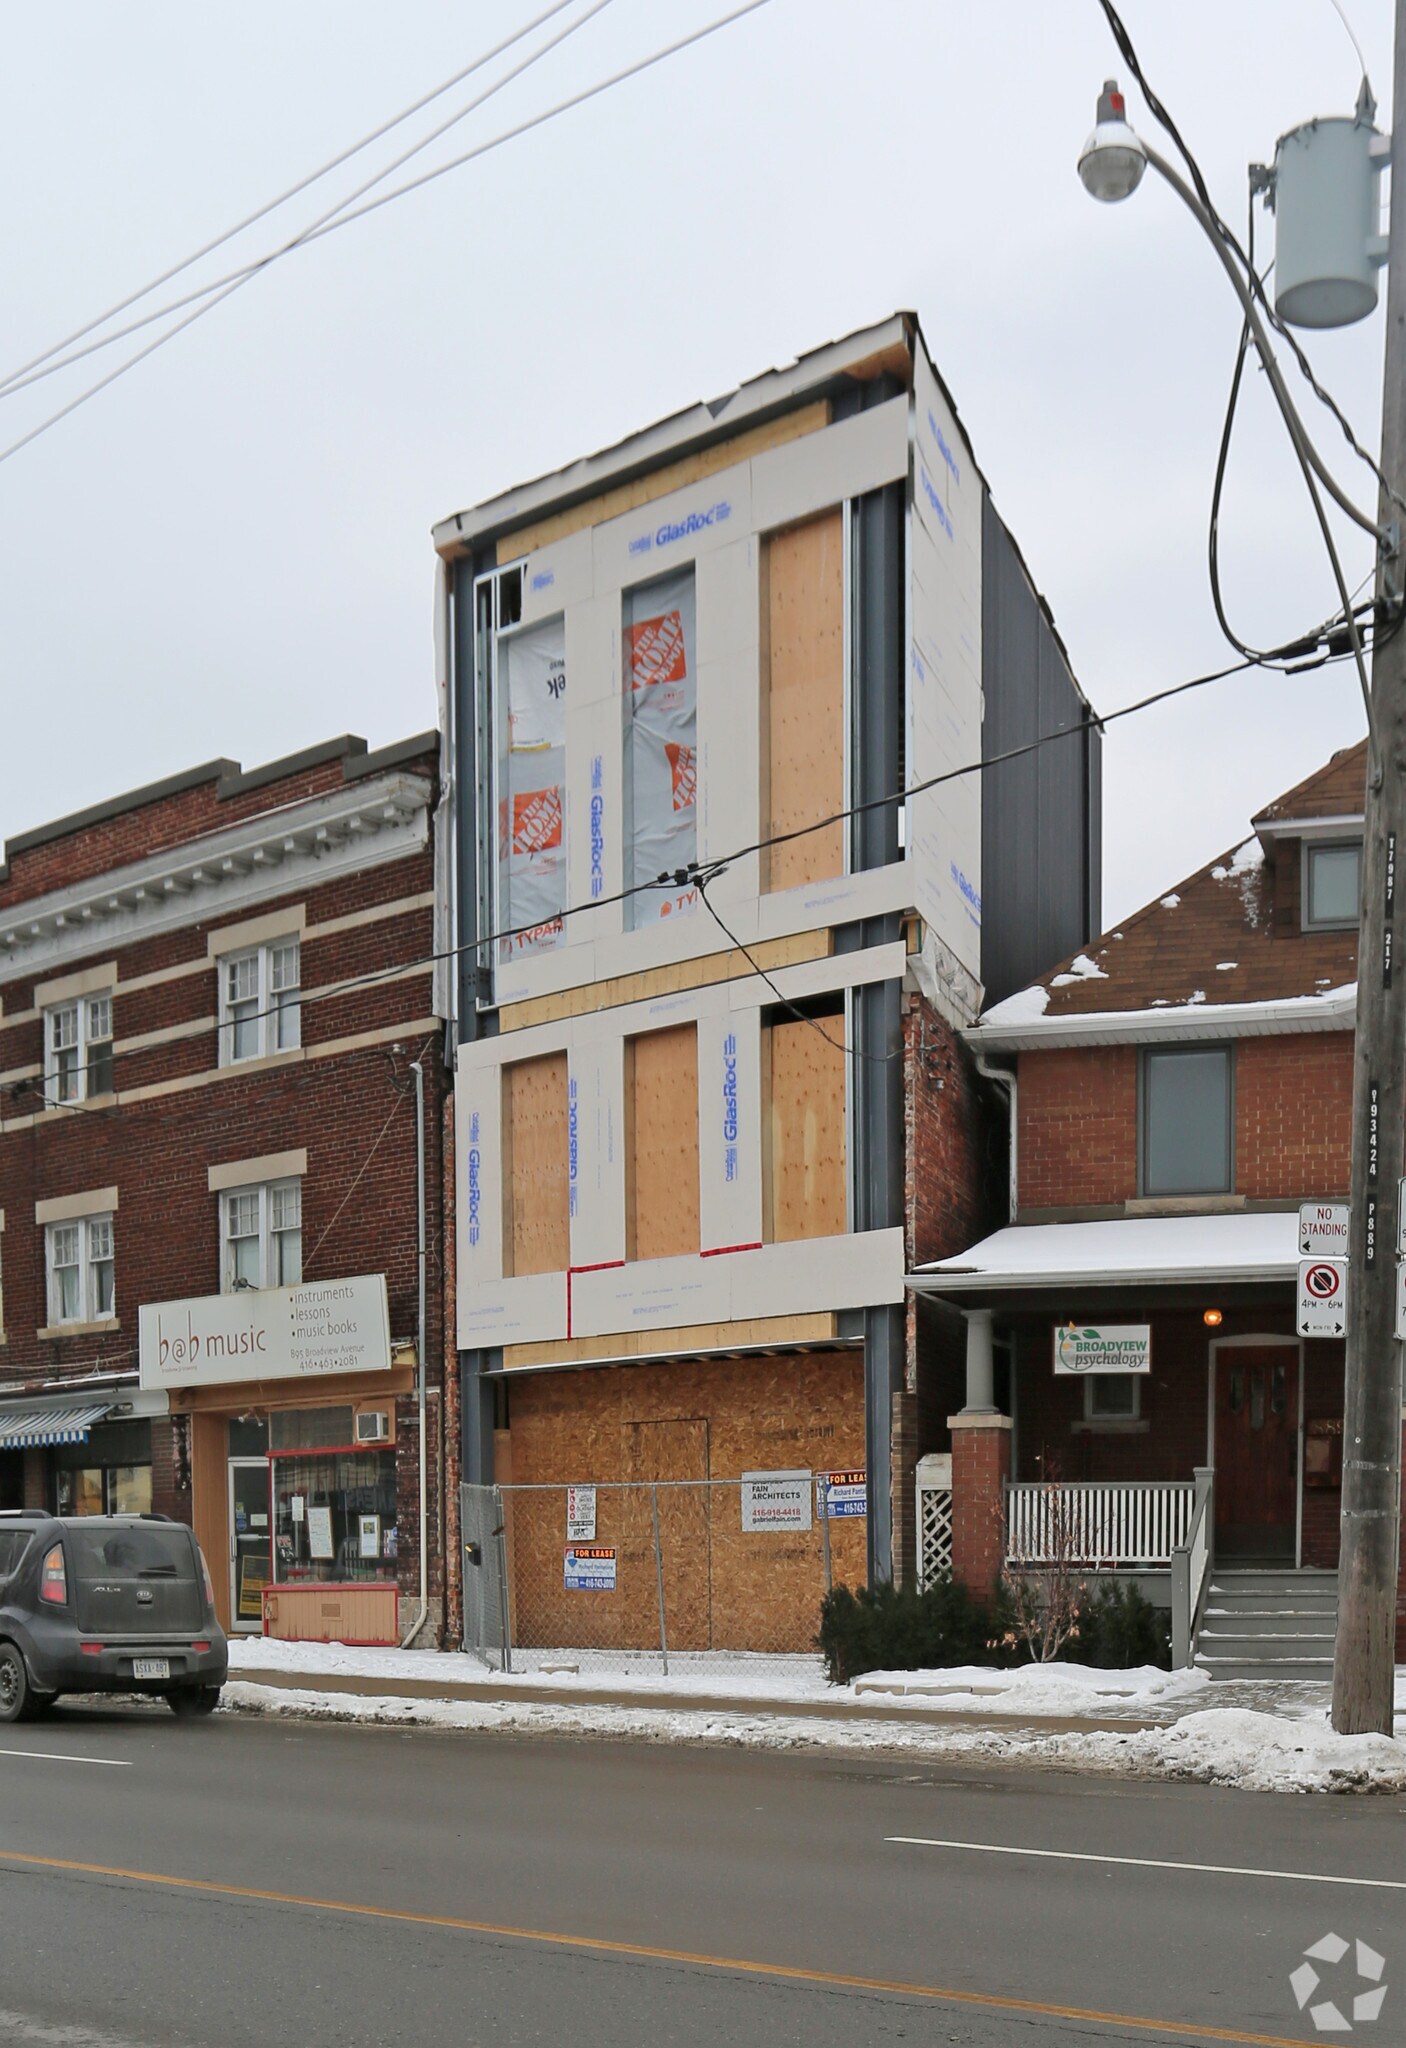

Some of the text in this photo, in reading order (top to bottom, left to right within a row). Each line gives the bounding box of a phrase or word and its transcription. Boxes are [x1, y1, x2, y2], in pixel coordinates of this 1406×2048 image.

[655, 508, 714, 547] GlasRoc
[519, 796, 542, 824] THE
[590, 794, 604, 876] GlasRoc
[723, 1056, 738, 1142] GlasRoc
[468, 1148, 481, 1224] GlasRoc
[1316, 1207, 1333, 1220] NO
[1301, 1222, 1348, 1237] STANDING
[1367, 1202, 1375, 1260] P889
[295, 1285, 355, 1305] instruments
[1301, 1299, 1318, 1309] 4PM
[1327, 1299, 1343, 1309] 6PM
[295, 1306, 331, 1321] lessons
[296, 1319, 358, 1339] music books
[205, 1324, 267, 1359] music
[1075, 1340, 1148, 1352] BROADVIEW
[290, 1343, 365, 1360] 895 Broadview Avenue
[1074, 1348, 1145, 1369] psychology
[829, 1474, 846, 1485] FOR
[752, 1485, 769, 1493] FAIN
[752, 1491, 801, 1500] ARCHITECTS
[833, 1487, 851, 1497] Richard
[752, 1508, 801, 1516] 416-918-4418
[752, 1515, 802, 1524] gabrielfain.com
[575, 1549, 615, 1559] FOR LEASE
